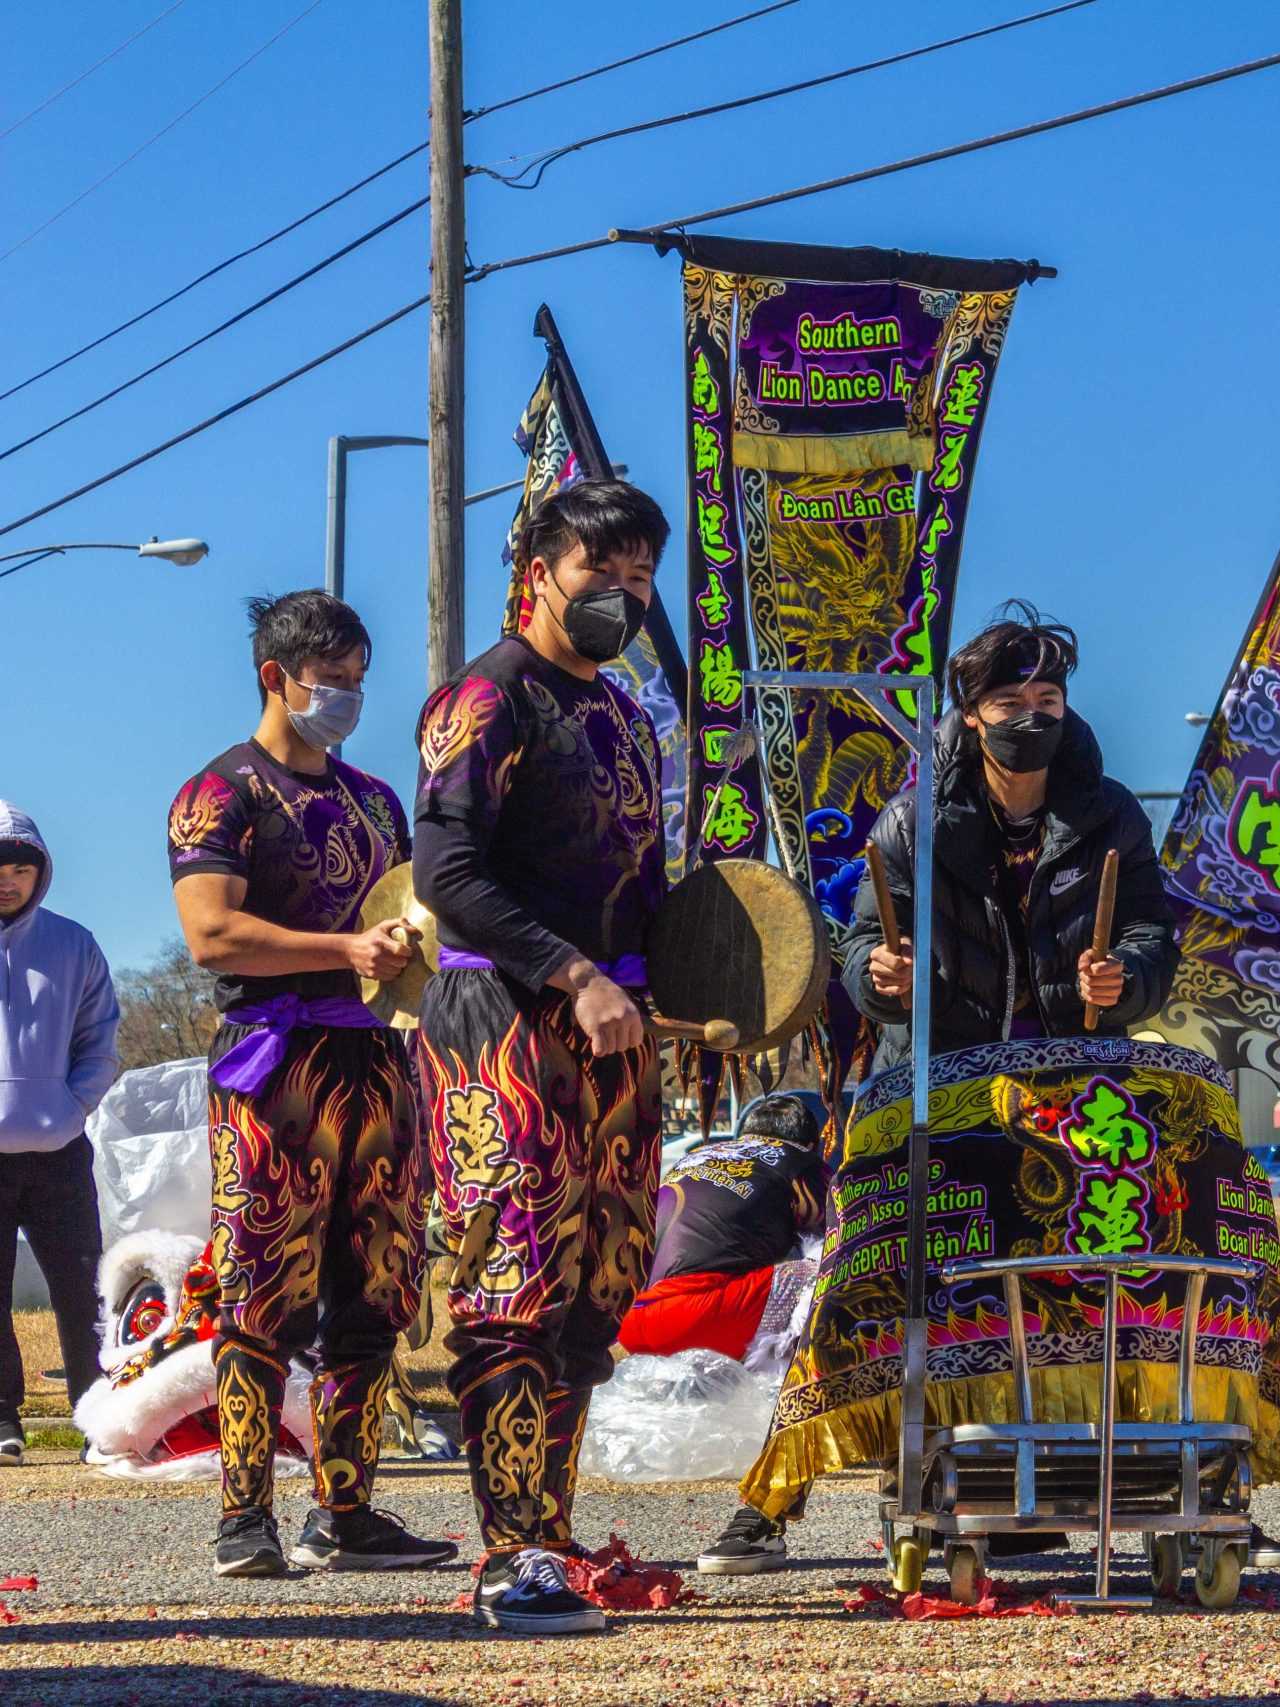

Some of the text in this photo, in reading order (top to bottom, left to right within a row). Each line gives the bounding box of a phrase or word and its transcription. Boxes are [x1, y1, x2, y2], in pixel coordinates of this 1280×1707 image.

[800, 318, 899, 349] Southern
[762, 367, 801, 400] Lion
[809, 370, 880, 401] Dance
[782, 494, 836, 519] Đoan
[839, 492, 882, 518] Lân
[1054, 866, 1081, 886] NIKE
[886, 1163, 942, 1191] Los
[1219, 1183, 1245, 1210] Lion
[840, 1214, 868, 1243] Dance
[871, 1186, 983, 1226] Assoation
[851, 1239, 893, 1276] GĐPT
[896, 1231, 960, 1265] Tiện
[966, 1218, 989, 1253] Ái
[1219, 1226, 1249, 1255] Đoan
